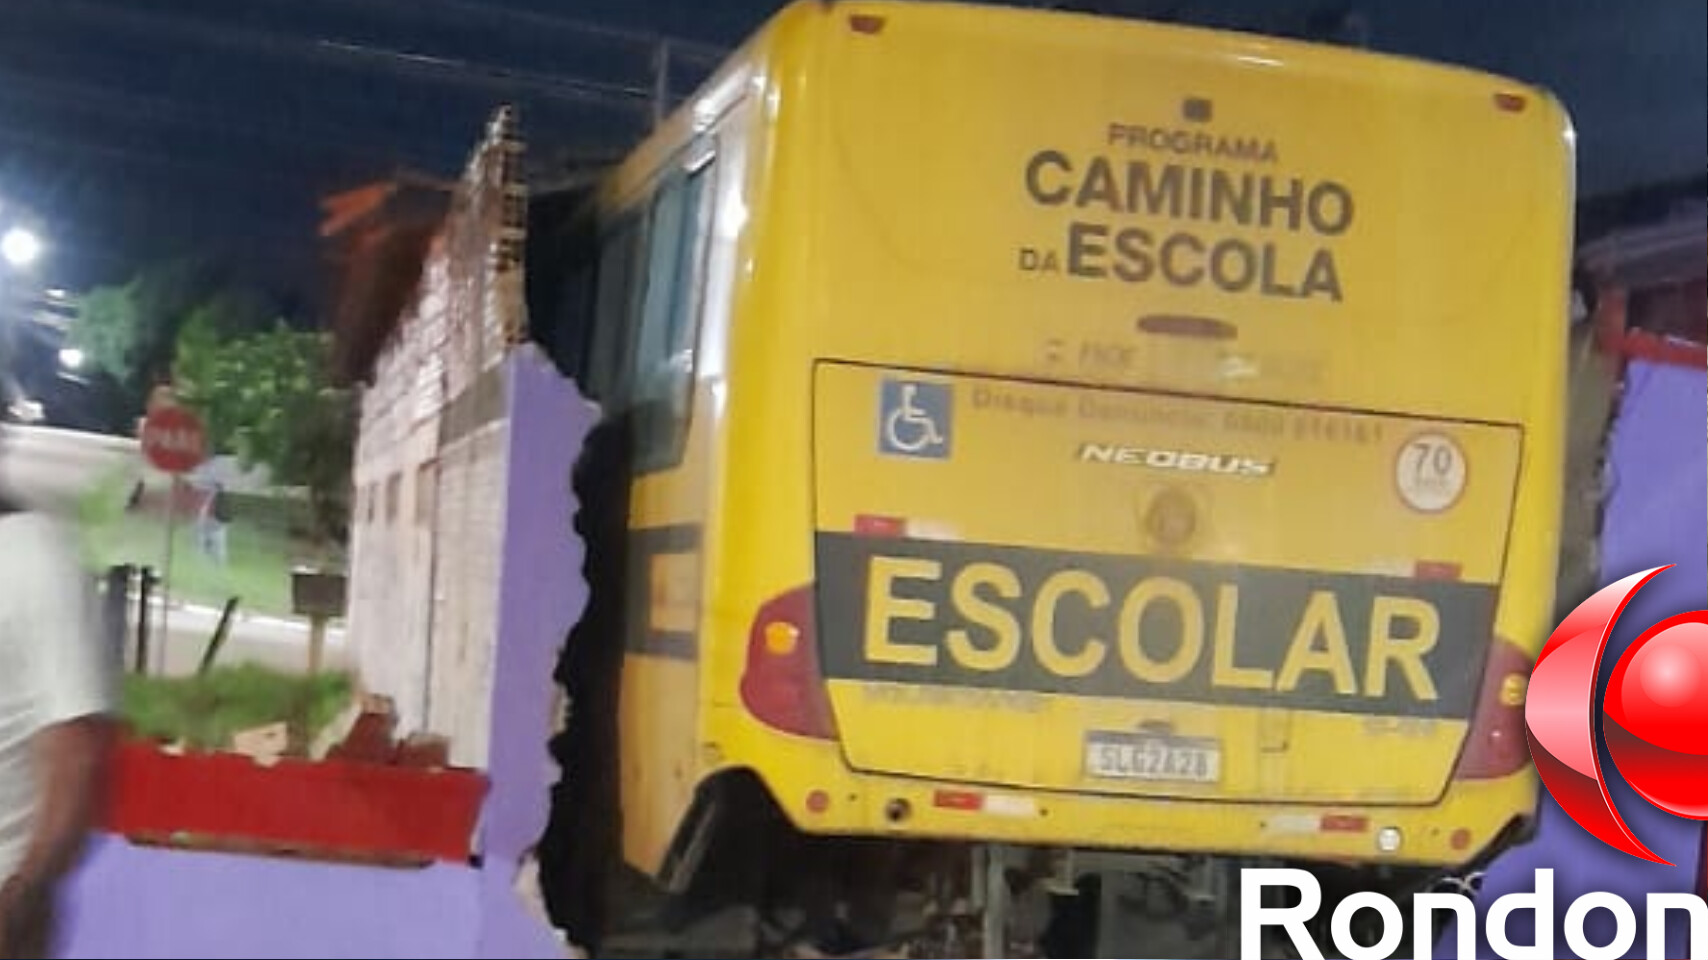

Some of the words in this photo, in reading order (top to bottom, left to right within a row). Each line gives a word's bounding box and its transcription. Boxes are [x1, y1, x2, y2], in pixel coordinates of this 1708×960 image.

[1107, 123, 1279, 163] PROGRAMA
[1024, 149, 1353, 237] CAMINHO
[1018, 246, 1060, 276] DA
[1067, 223, 1344, 303] ESCOLA
[1081, 444, 1271, 476] NEOBUS
[1413, 441, 1452, 475] 70
[863, 555, 1439, 701] ESCOLAR
